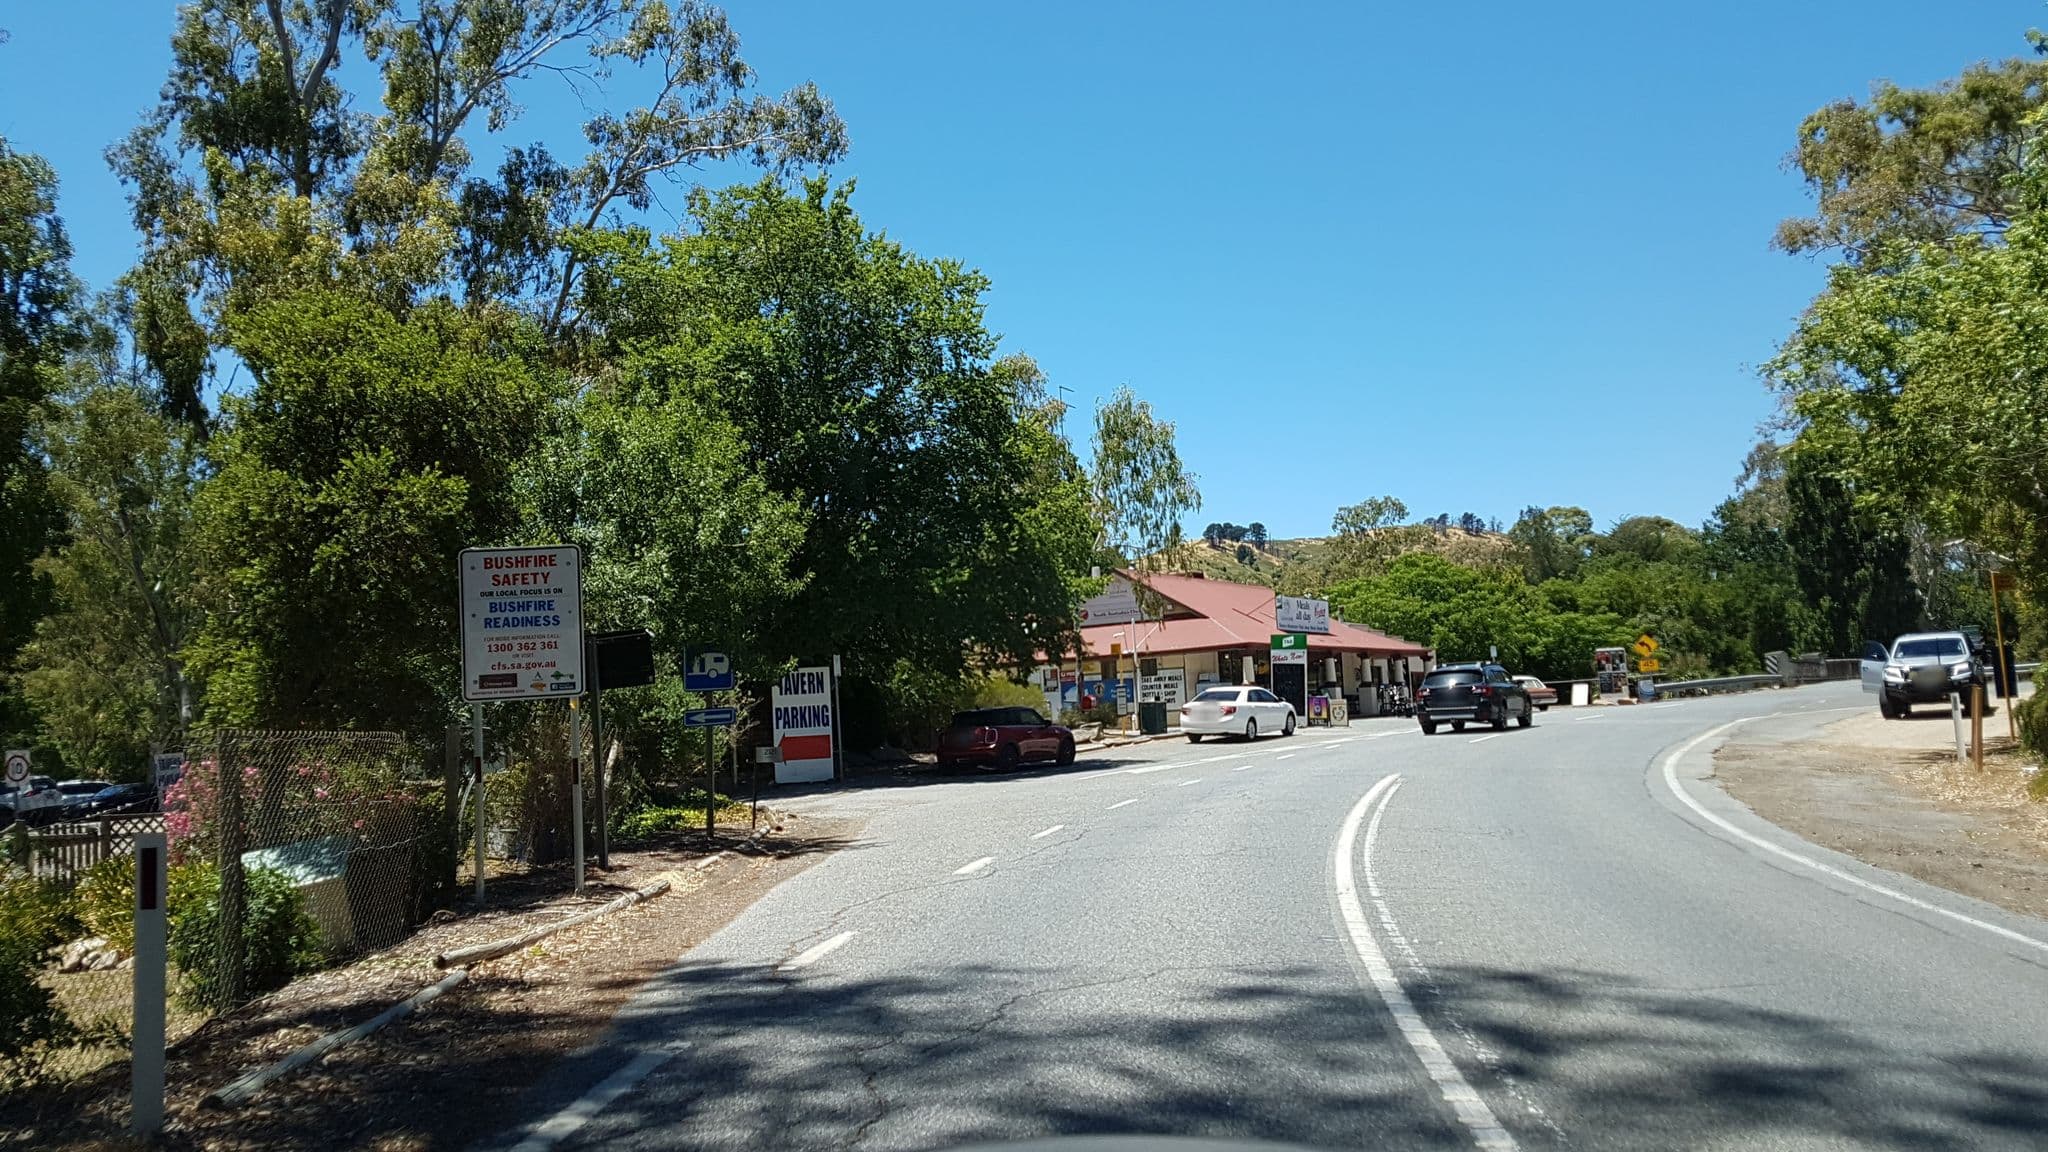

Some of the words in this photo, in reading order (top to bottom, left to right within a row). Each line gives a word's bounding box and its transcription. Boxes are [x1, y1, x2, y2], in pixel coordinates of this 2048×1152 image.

[483, 554, 557, 570] BUSHFIRE
[491, 572, 551, 587] SAFETY
[520, 588, 542, 596] FOCUS
[553, 587, 563, 595] ON
[489, 600, 555, 613] BUSHFIRE
[483, 615, 561, 629] READINESS
[487, 643, 513, 653] 1300
[517, 641, 537, 652] 362
[540, 640, 559, 651] 361
[491, 661, 557, 671] cfs.sa.gov.au
[775, 704, 830, 730] PARKING
